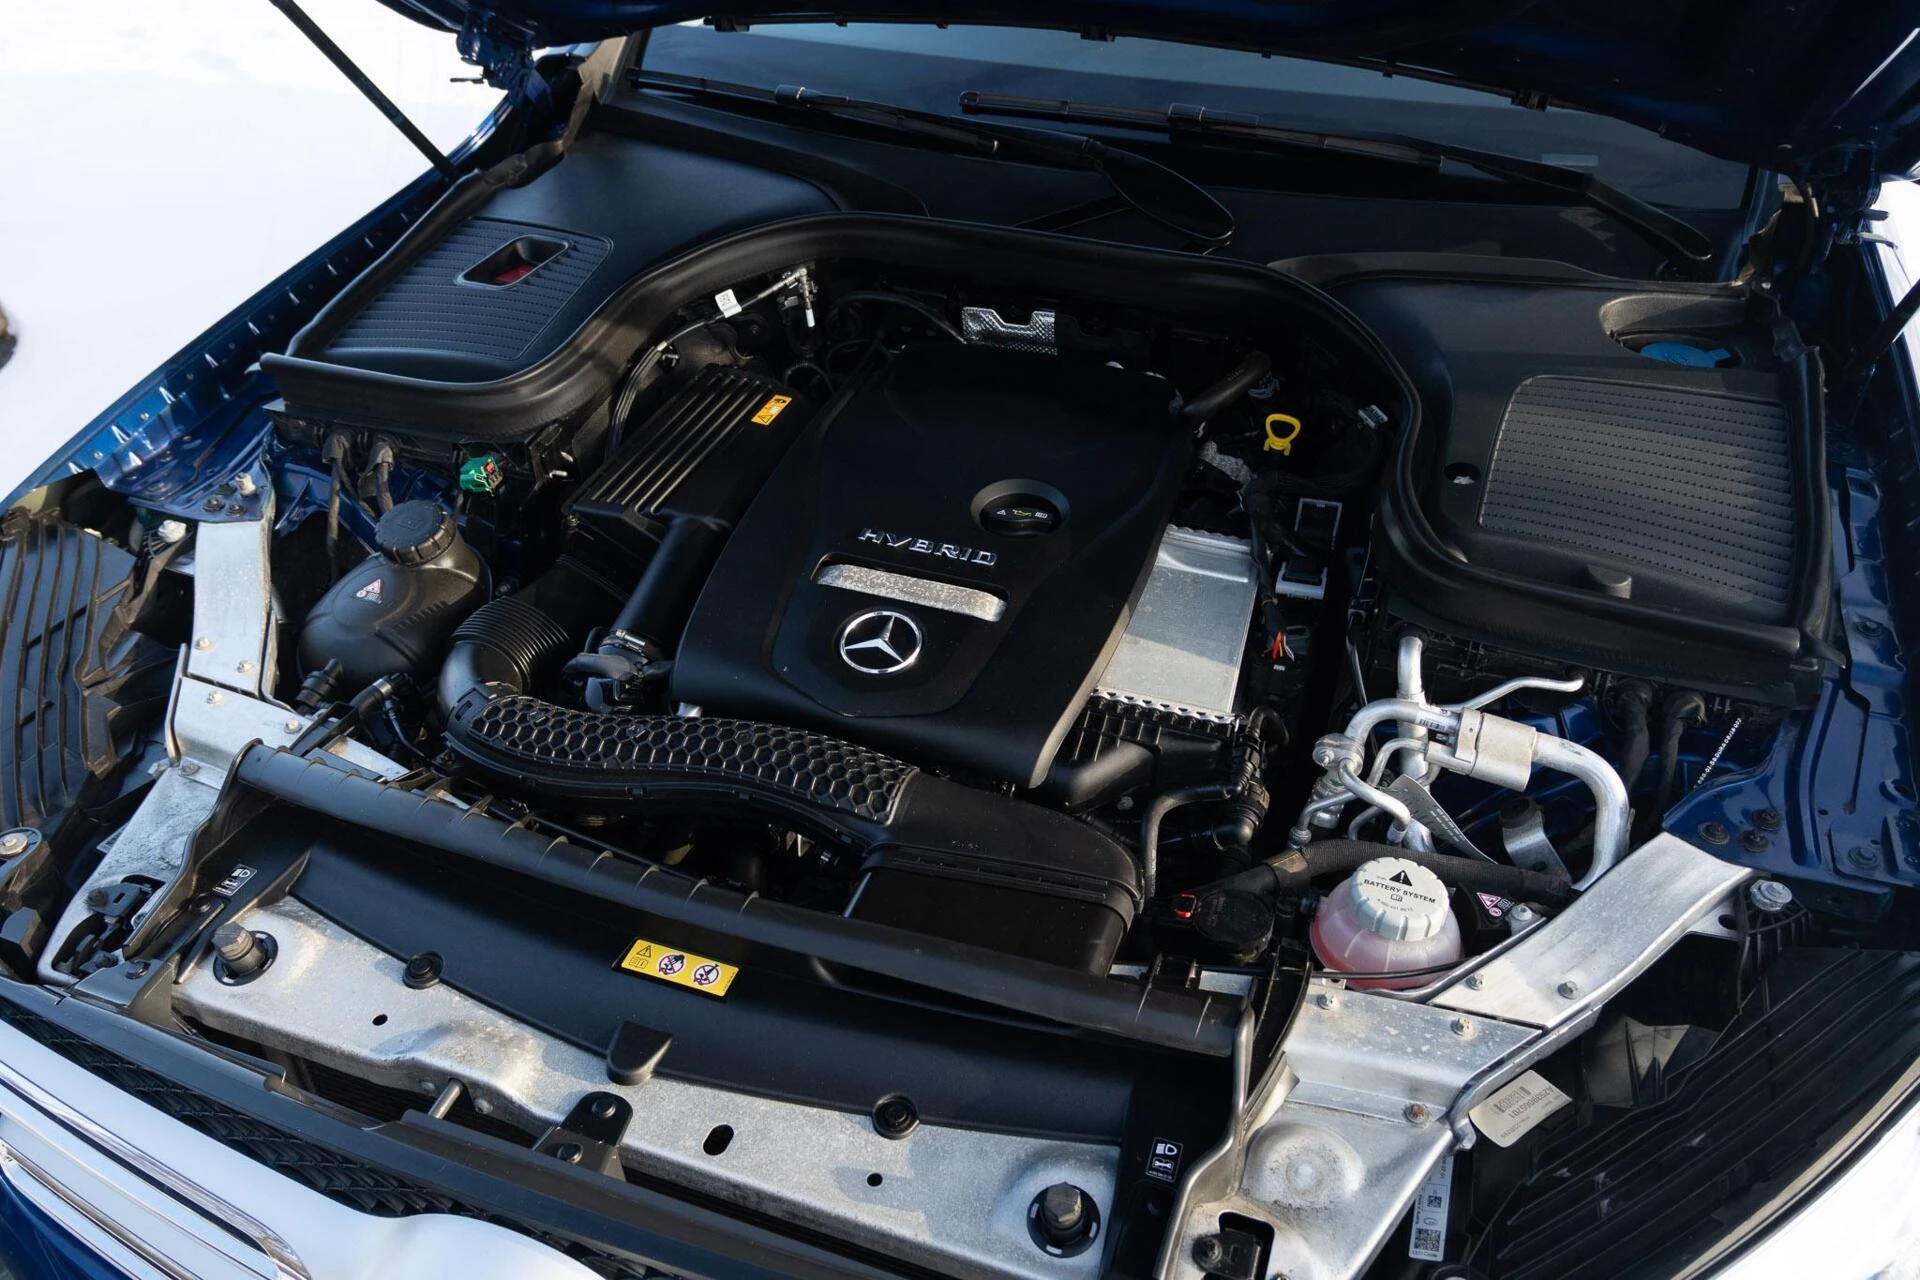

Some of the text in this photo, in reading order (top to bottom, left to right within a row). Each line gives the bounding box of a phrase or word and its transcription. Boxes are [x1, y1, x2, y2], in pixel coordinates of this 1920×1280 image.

[858, 528, 997, 566] HYBRID
[1363, 879, 1436, 904] BATTERY SYSTEM
